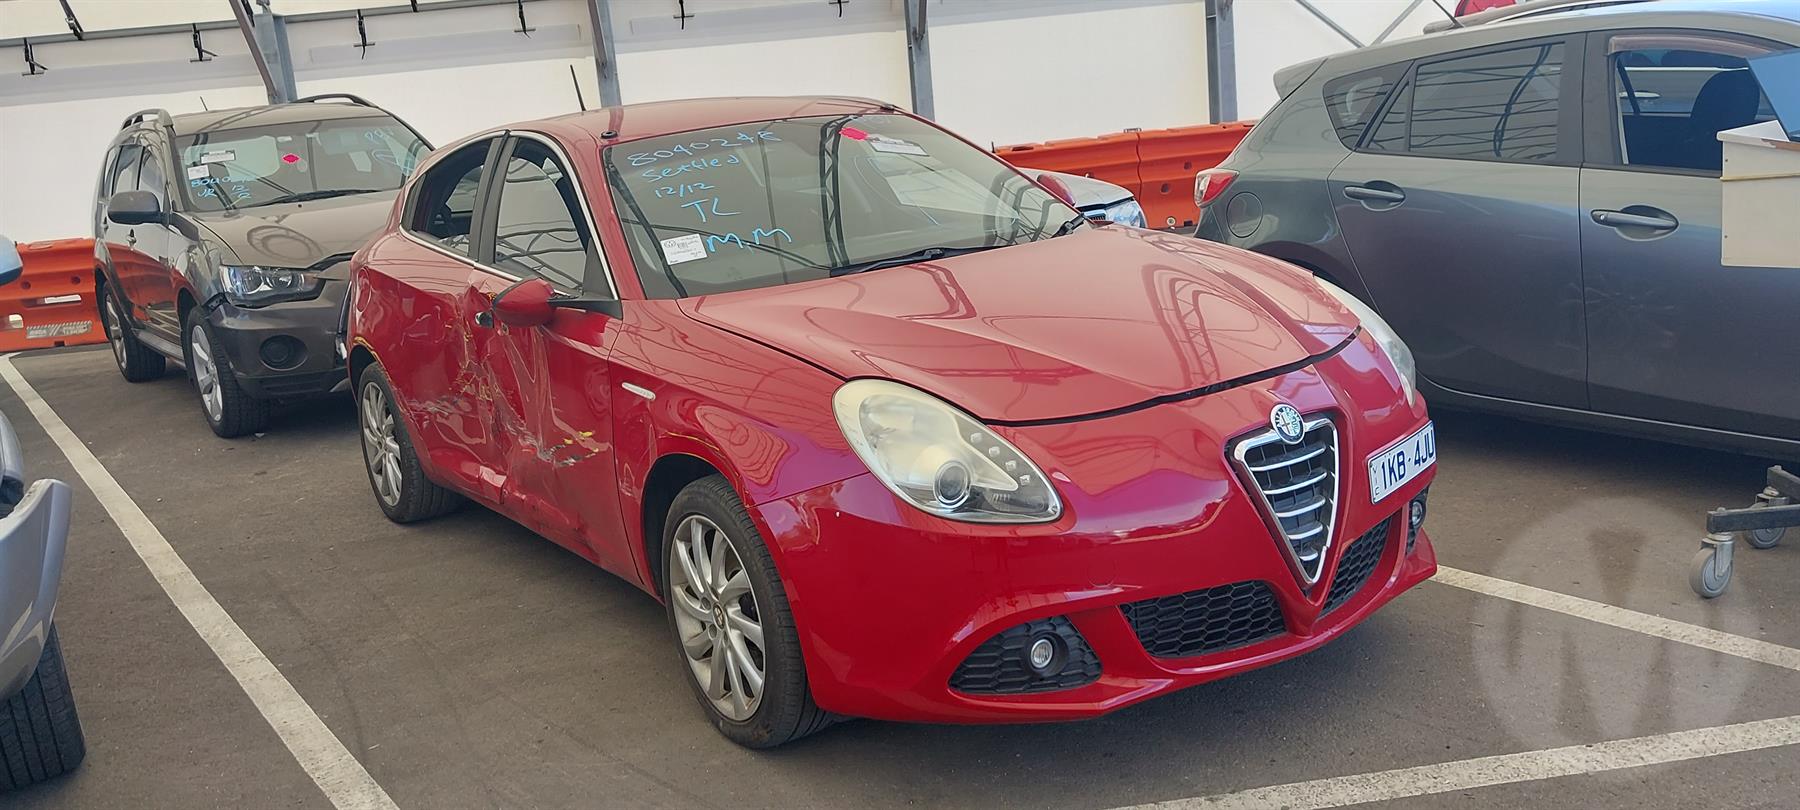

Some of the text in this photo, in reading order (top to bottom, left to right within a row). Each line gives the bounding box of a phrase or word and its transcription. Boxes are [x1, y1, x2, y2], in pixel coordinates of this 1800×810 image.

[641, 154, 740, 182] Settled
[655, 182, 715, 198] 12/12
[681, 197, 742, 223] TL
